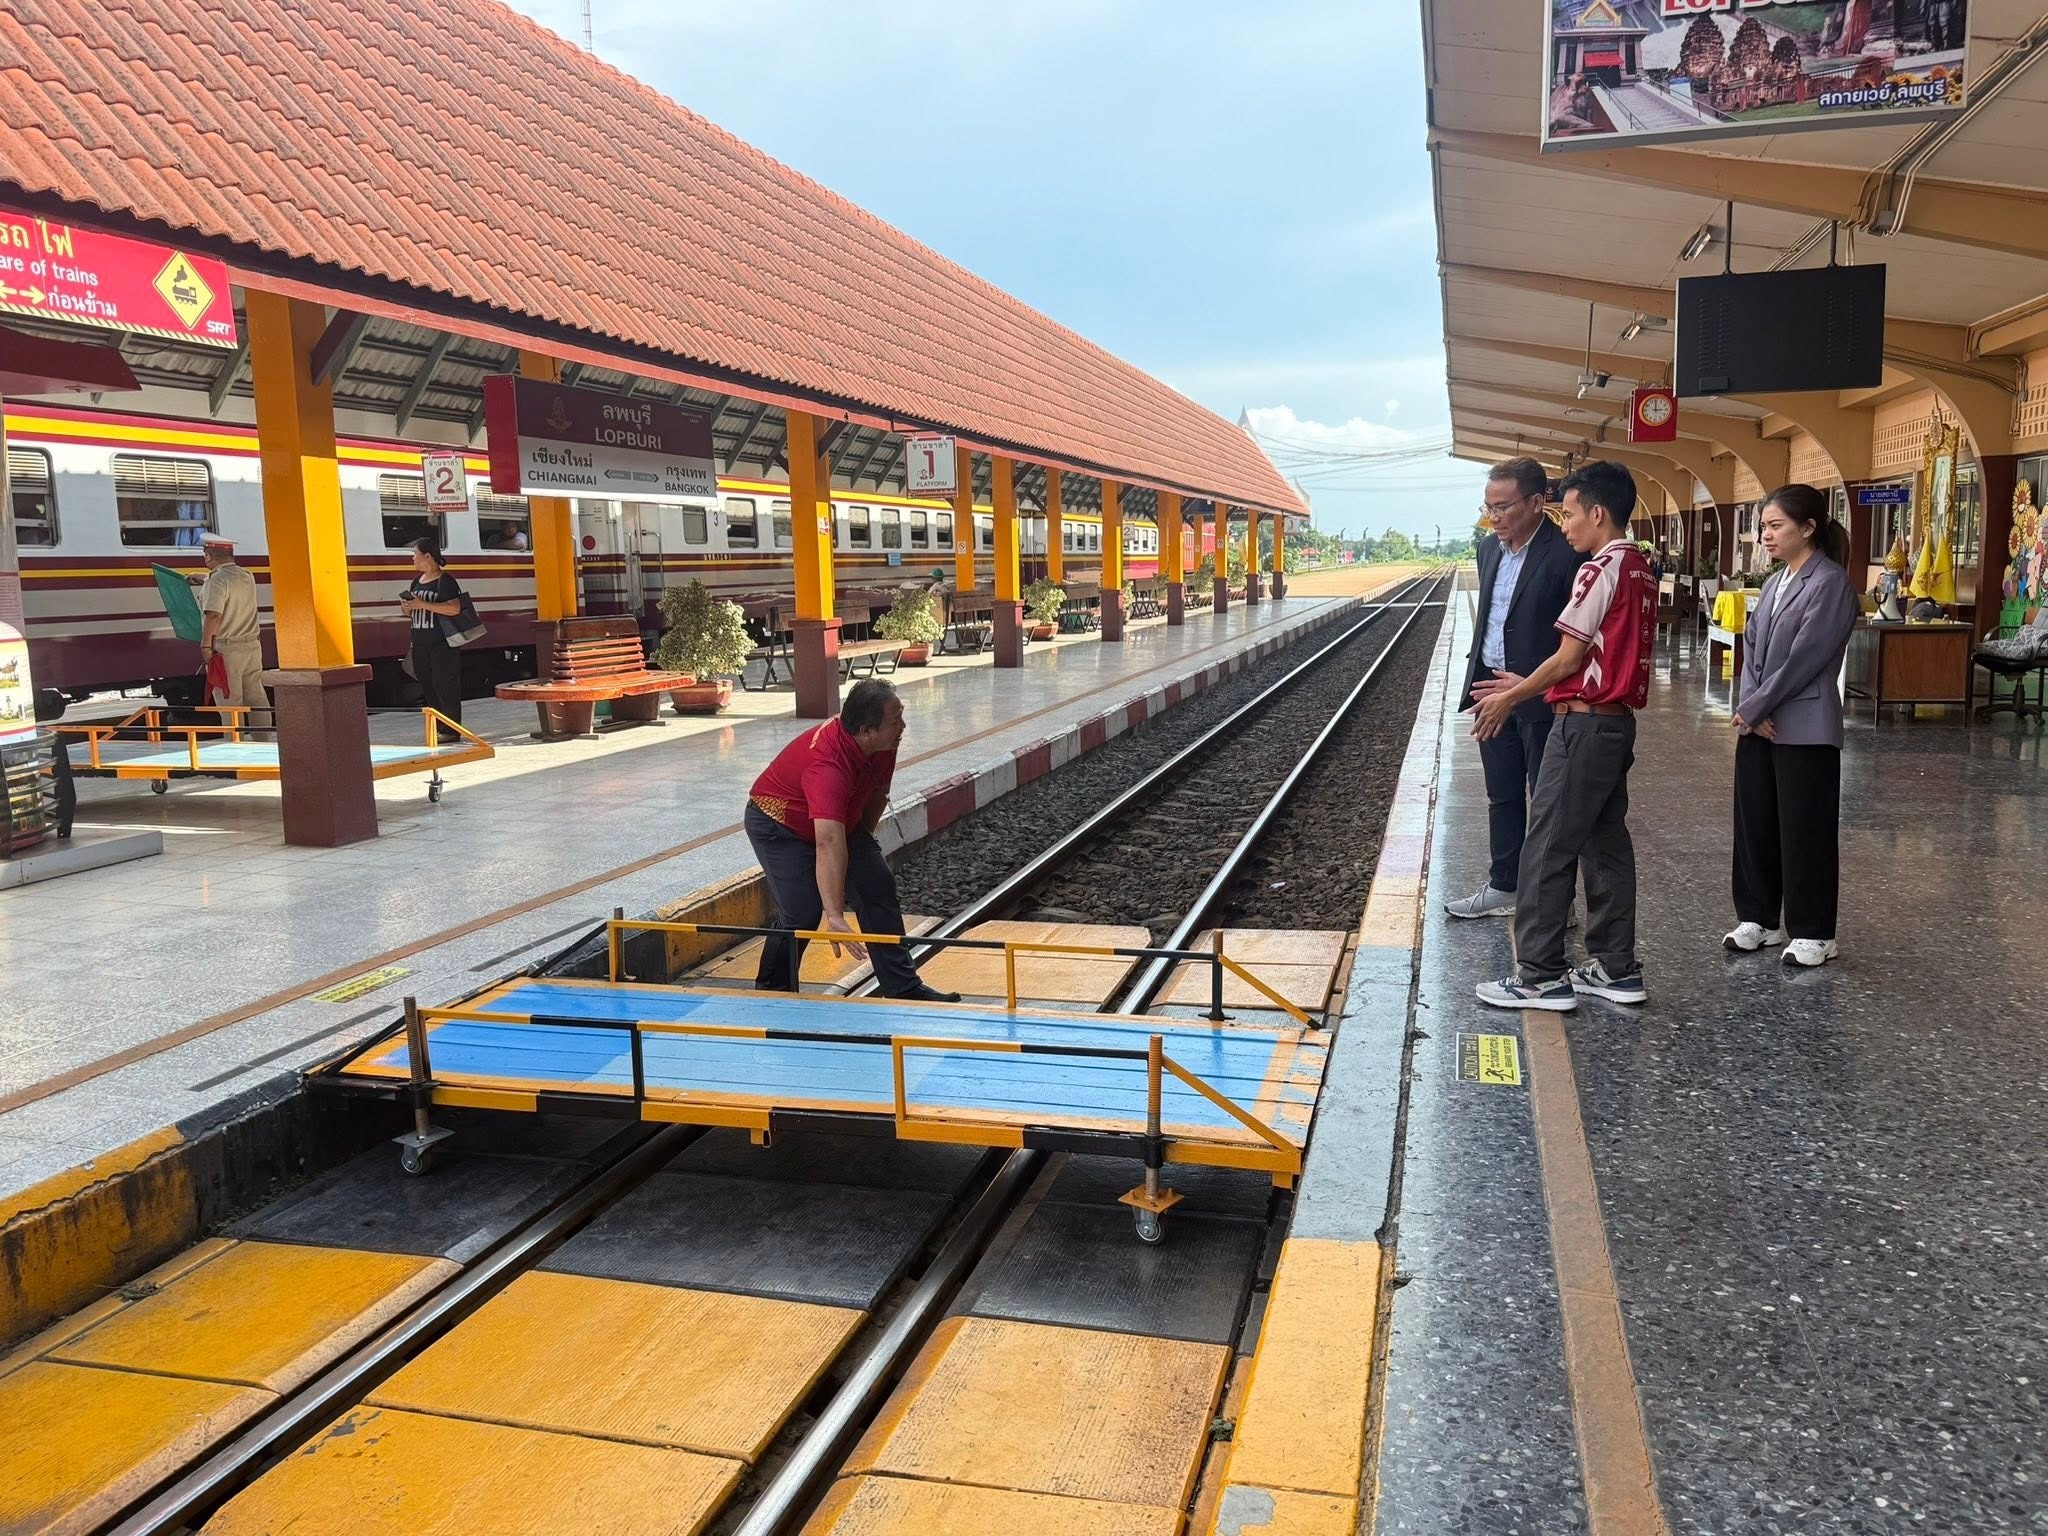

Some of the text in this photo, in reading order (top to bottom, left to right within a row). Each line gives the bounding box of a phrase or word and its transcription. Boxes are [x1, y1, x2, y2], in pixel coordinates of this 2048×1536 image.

[1819, 79, 1945, 106] สกายเวย์ ลพบุรี
[30, 259, 47, 277] of
[52, 261, 99, 286] trains
[48, 285, 118, 317] ก่อนข้าม
[206, 320, 232, 336] SRT
[602, 404, 651, 430] ลพบุรี
[594, 427, 662, 450] LOPBURI
[532, 447, 593, 468] เชียงใหม่
[923, 450, 935, 479] 1
[435, 467, 456, 494] 2
[527, 470, 597, 485] CHIANGMAI
[665, 466, 707, 481] กรุงเทพ
[664, 482, 709, 494] BANGKOK
[713, 511, 719, 527] 3
